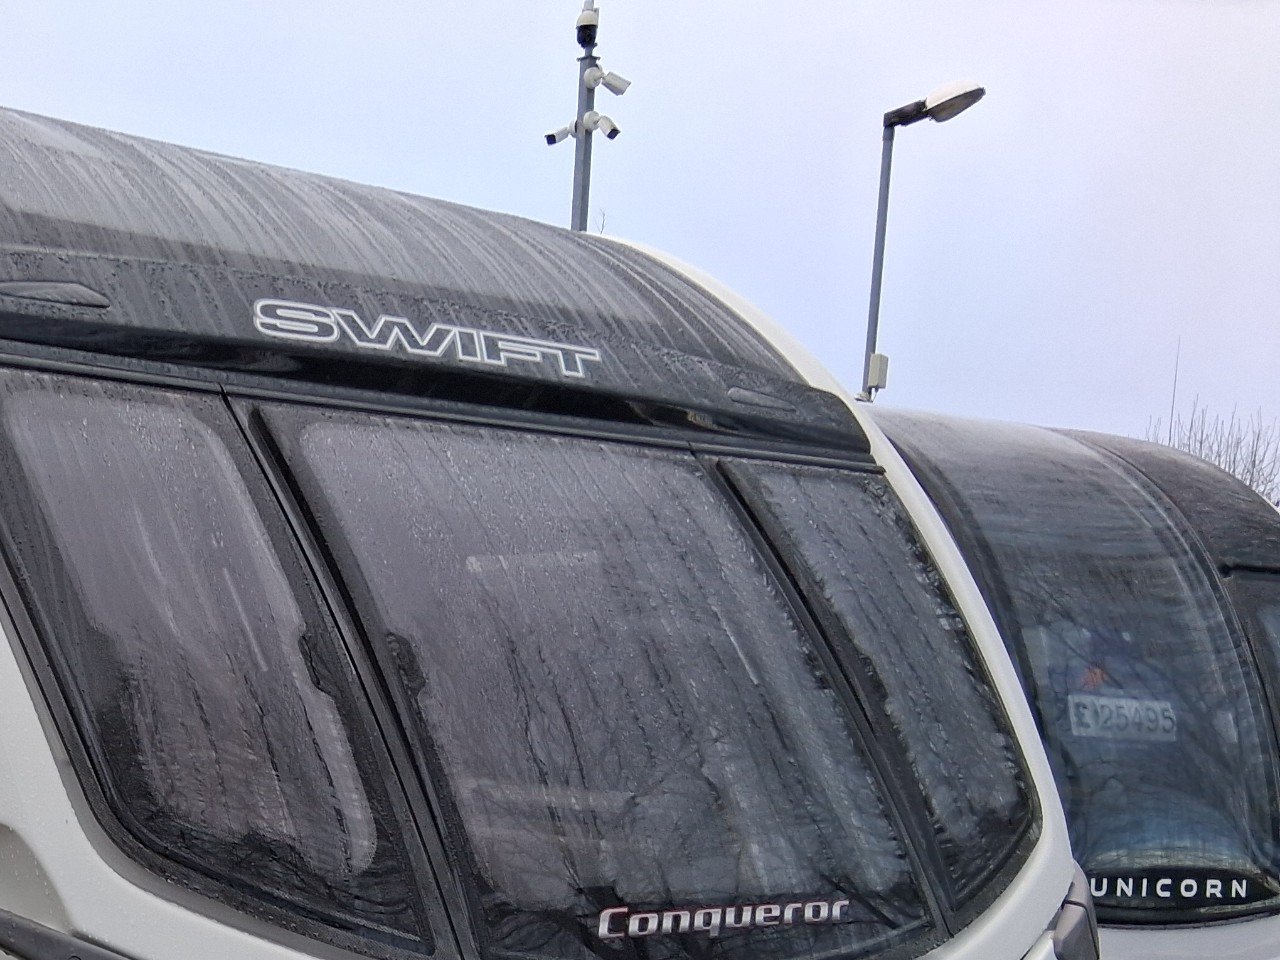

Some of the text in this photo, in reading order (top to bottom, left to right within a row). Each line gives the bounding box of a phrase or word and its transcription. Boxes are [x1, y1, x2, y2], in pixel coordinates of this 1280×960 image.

[253, 298, 602, 379] SWIFT
[1090, 877, 1247, 898] UNICORN
[597, 899, 851, 939] Conqueror
